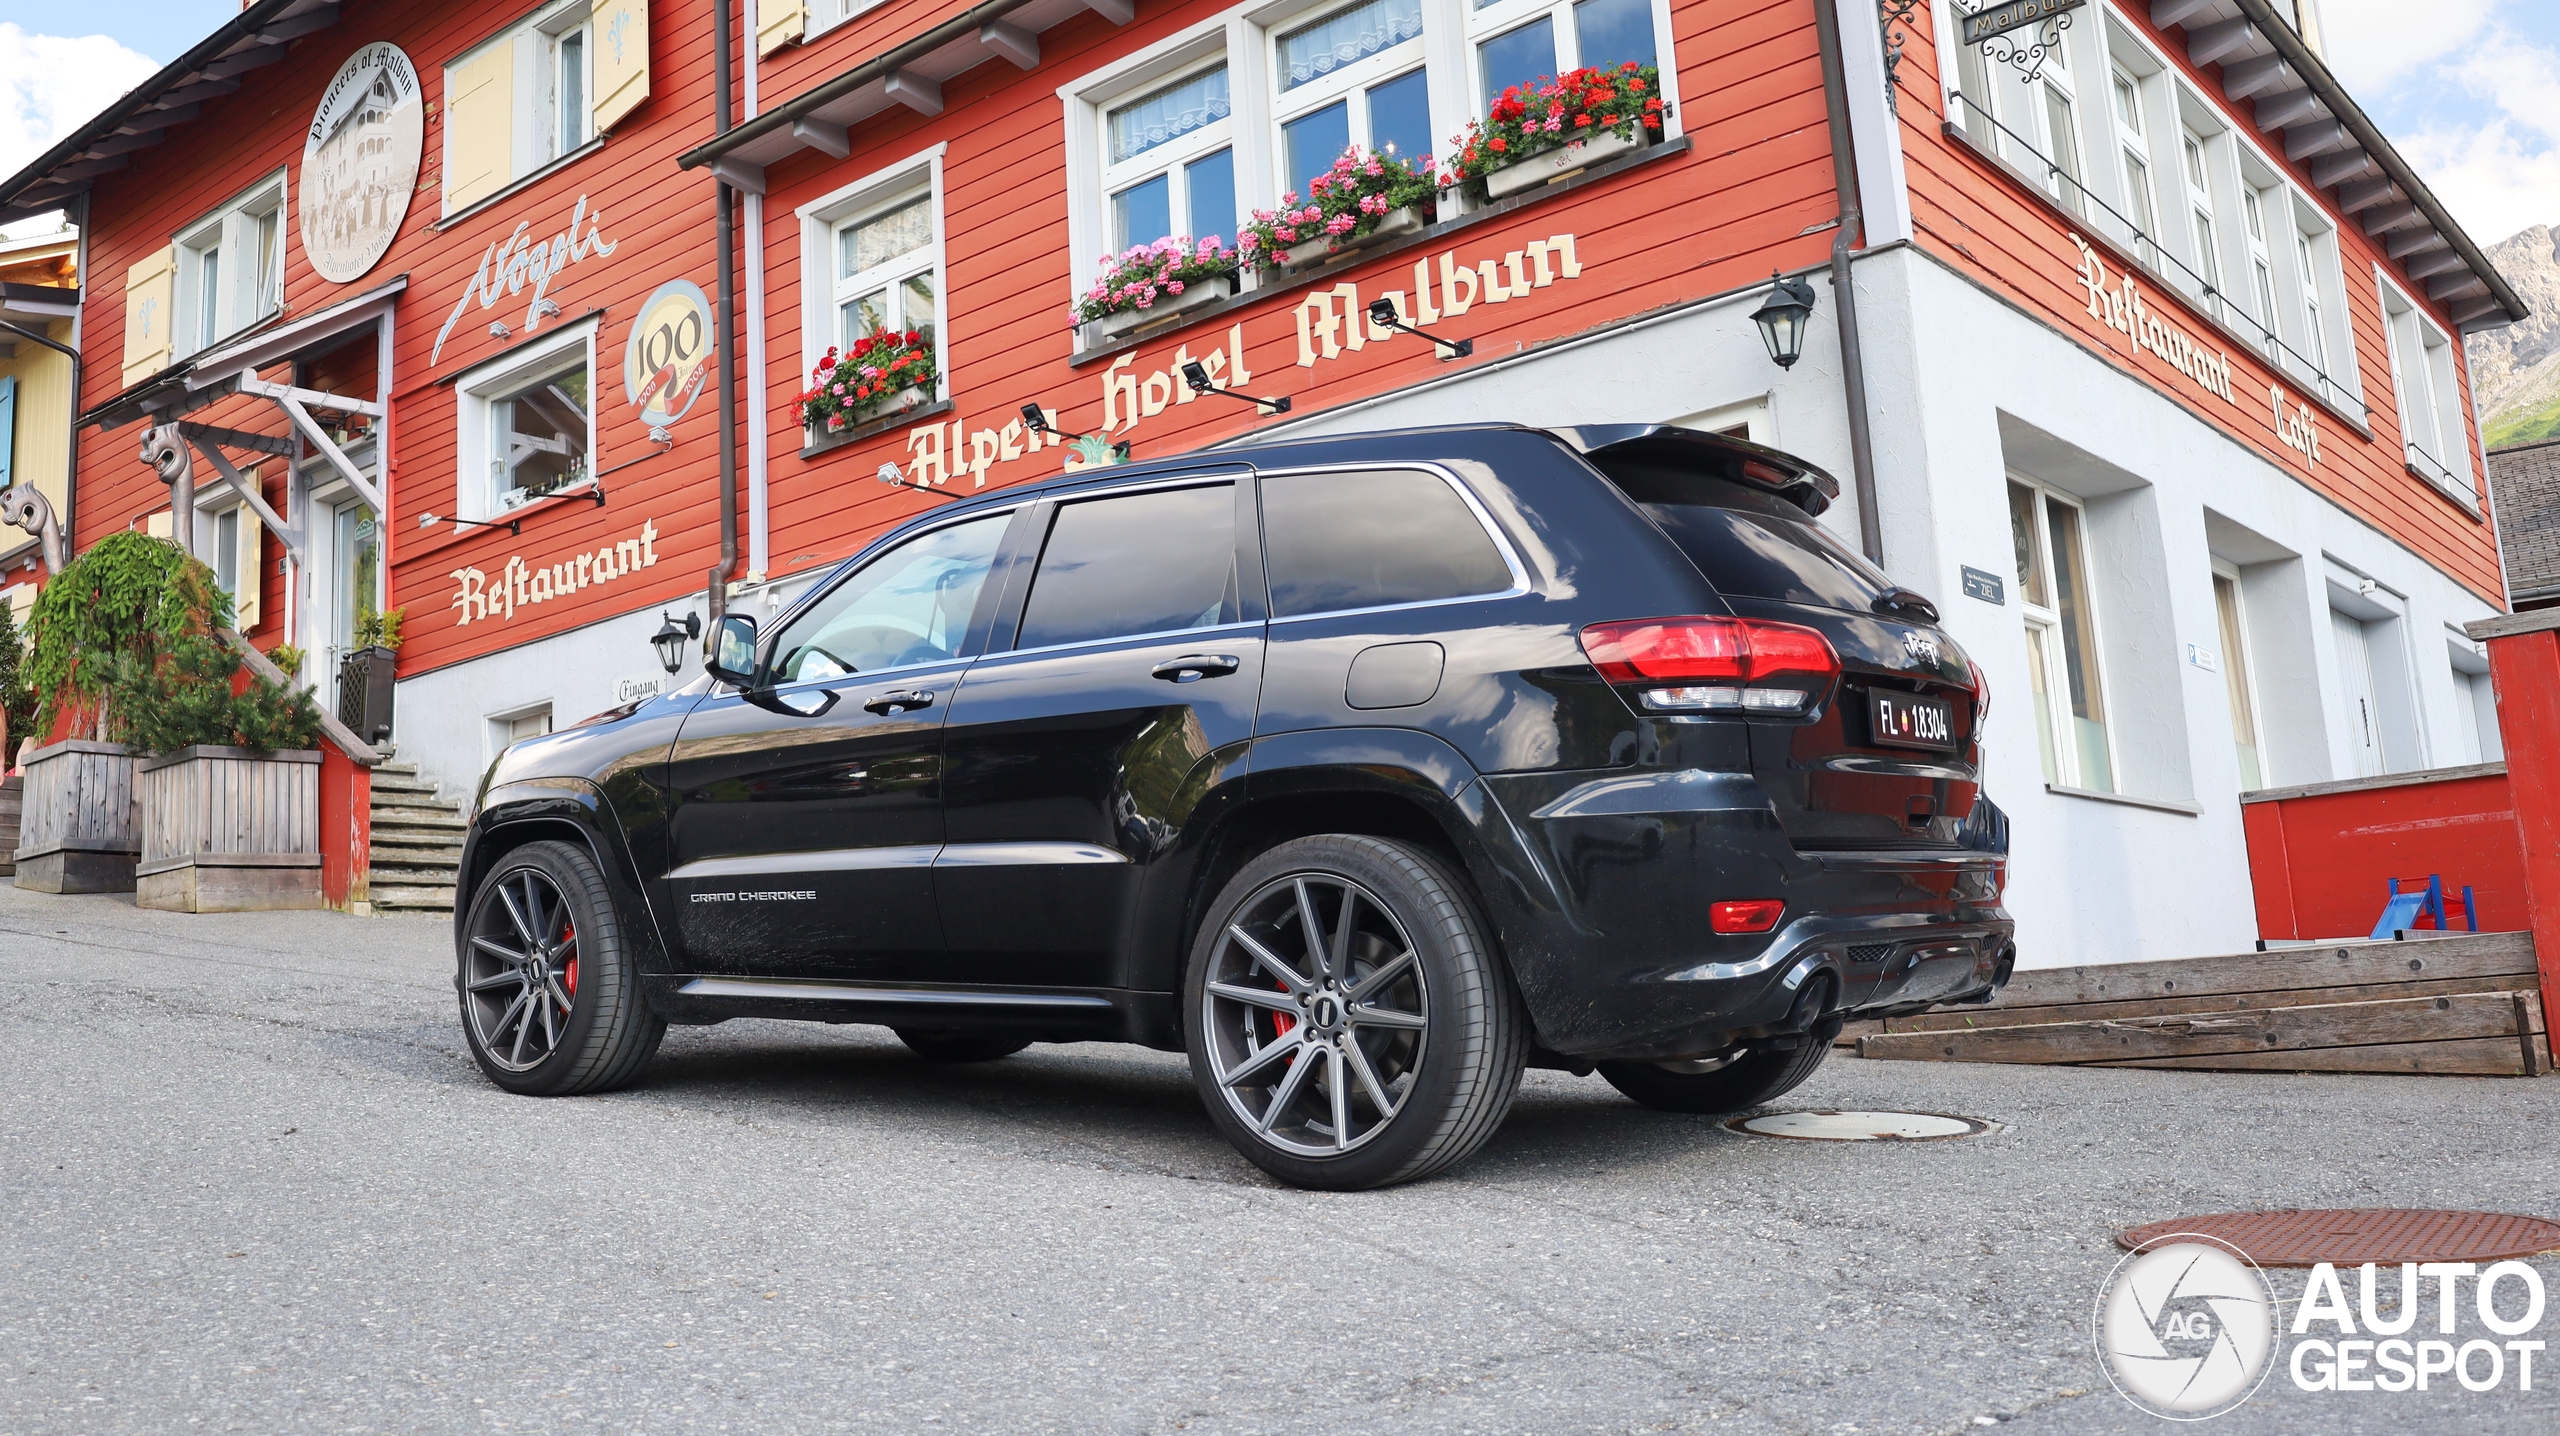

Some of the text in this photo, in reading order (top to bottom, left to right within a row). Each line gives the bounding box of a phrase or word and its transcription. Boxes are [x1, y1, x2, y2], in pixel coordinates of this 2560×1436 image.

[311, 46, 412, 144] Pioneers of Malbun
[638, 310, 702, 382] 100
[2068, 232, 2235, 405] Restaurant
[638, 364, 704, 406] 1908 2008
[906, 408, 1062, 493] Alpen
[1292, 233, 1582, 368] Malbun
[450, 517, 659, 626] Restaurant
[1903, 631, 1940, 669] Jeep
[619, 680, 659, 702] Eingang
[1880, 700, 1947, 741] FL 18304
[691, 890, 817, 903] GRAND CHEROKEE
